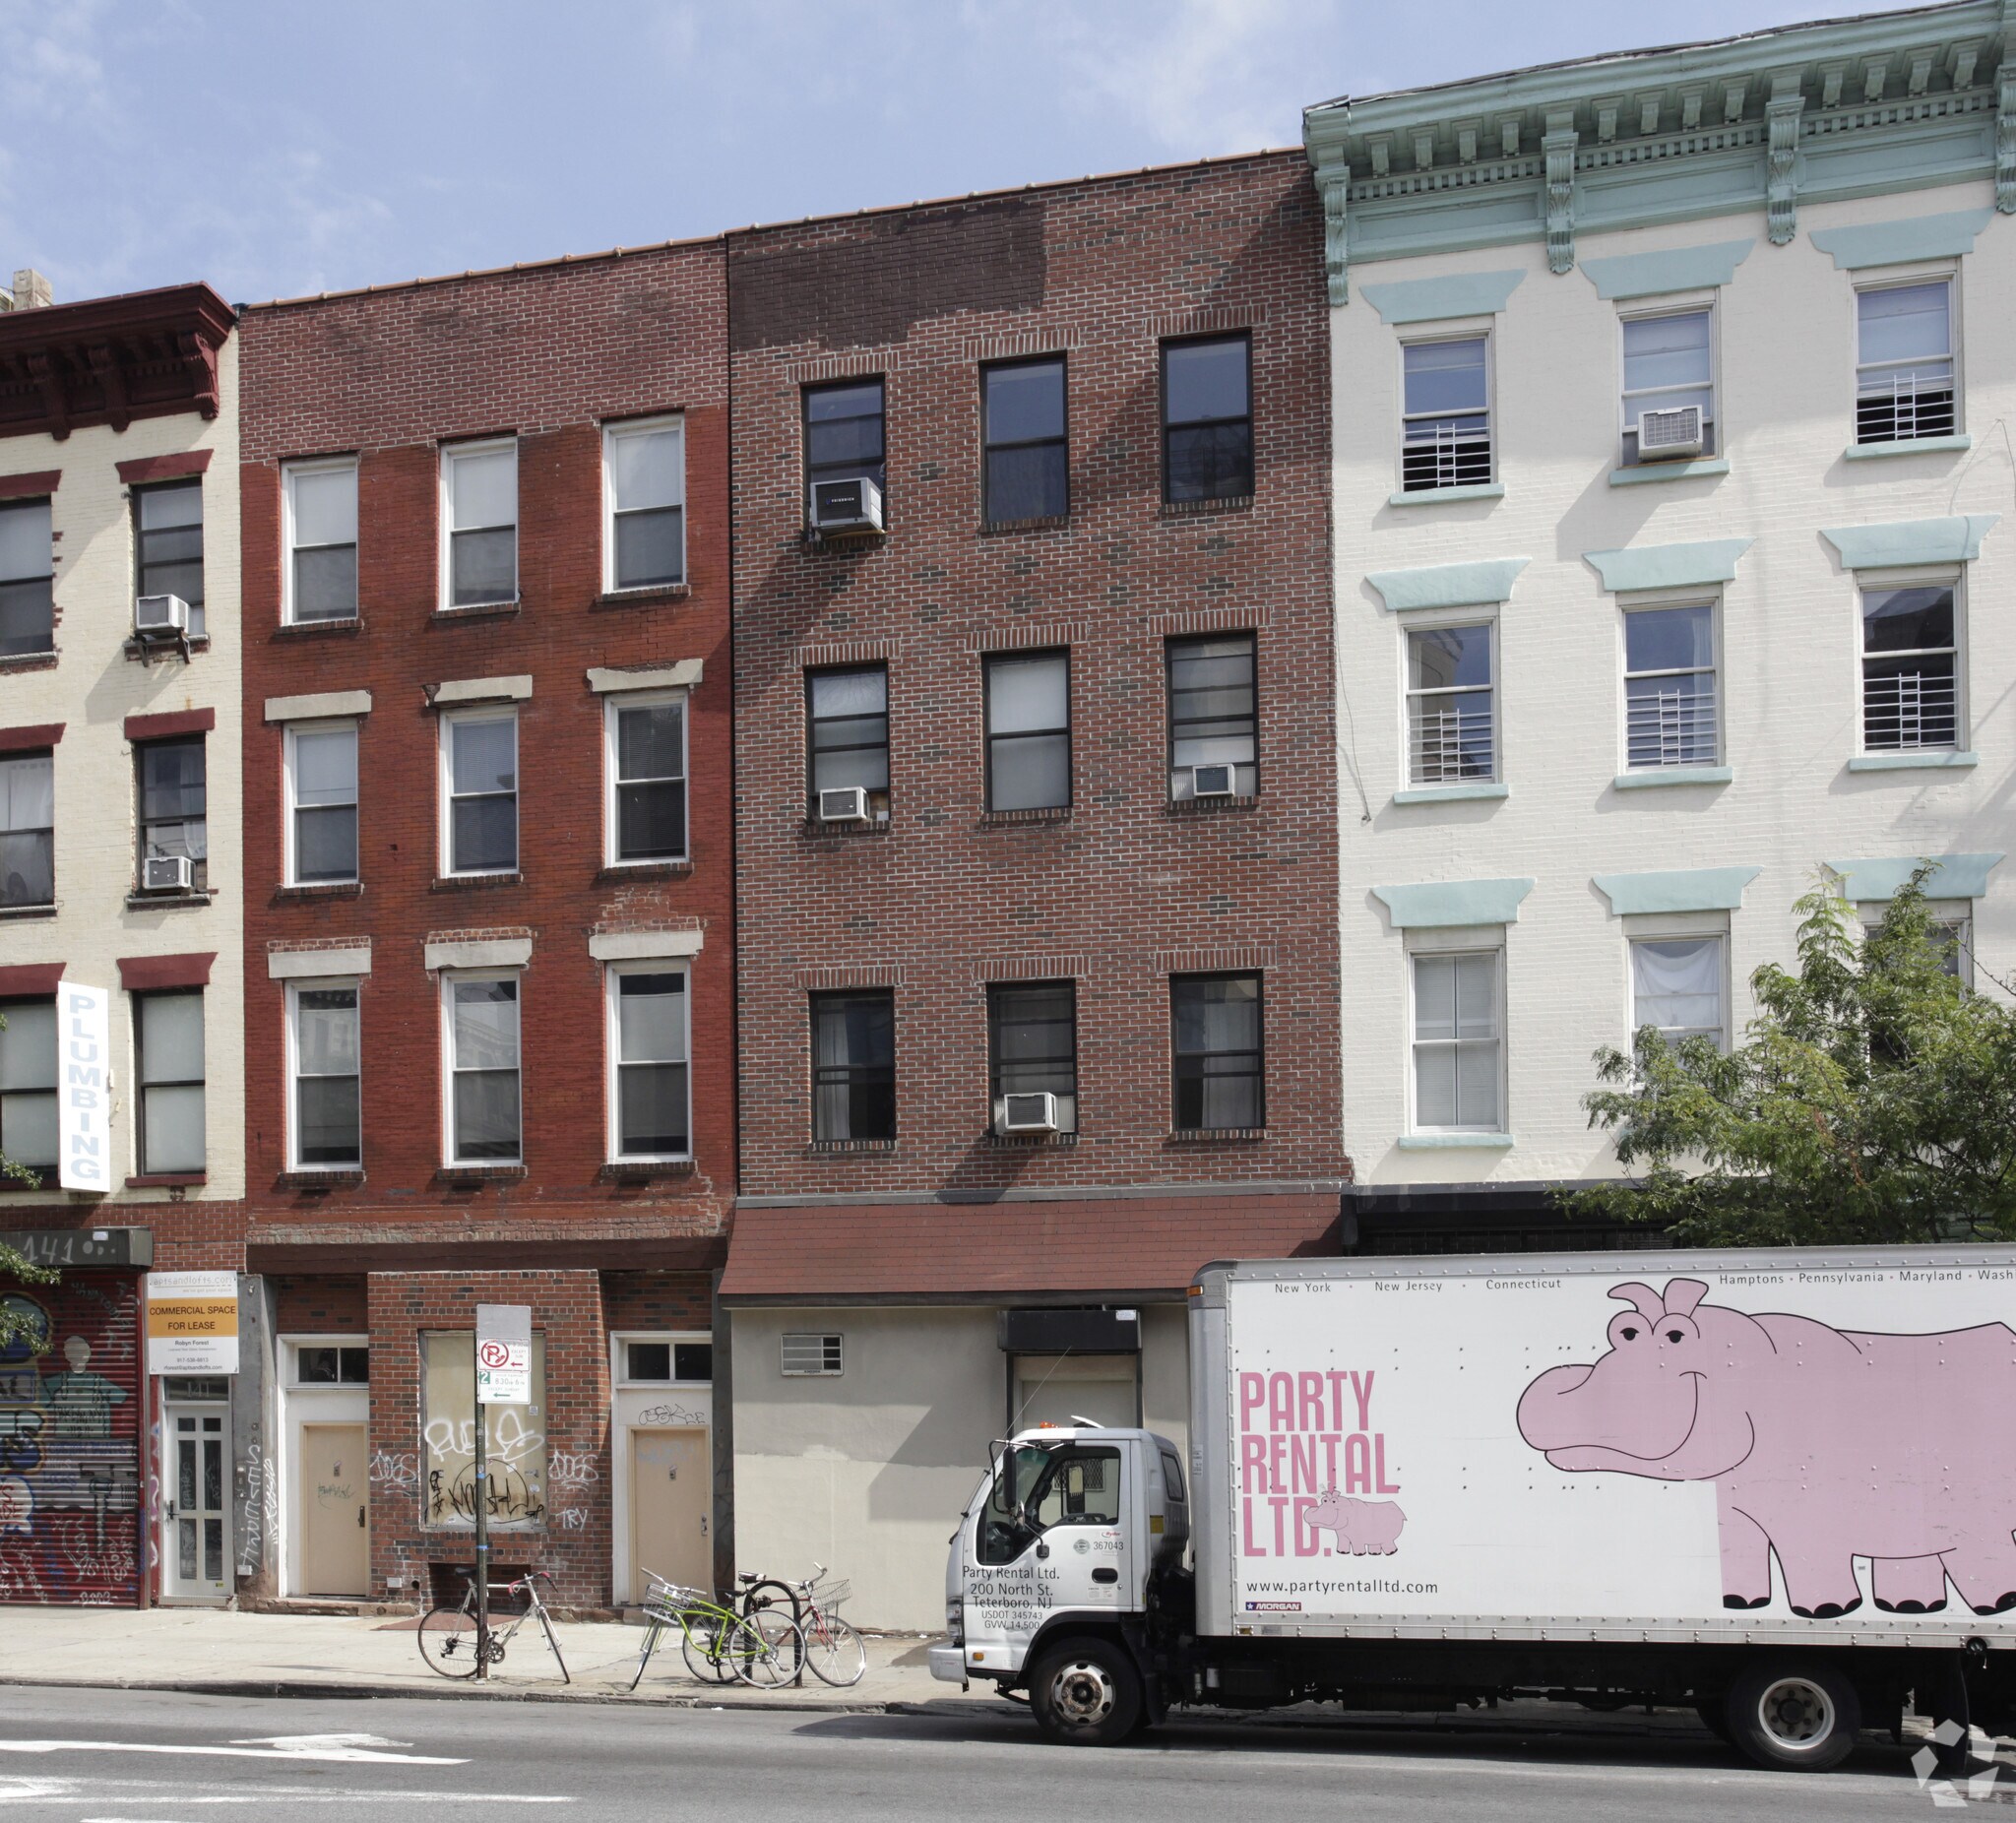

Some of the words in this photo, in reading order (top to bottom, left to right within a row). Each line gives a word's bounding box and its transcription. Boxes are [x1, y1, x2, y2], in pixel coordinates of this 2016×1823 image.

[69, 994, 100, 1179] PLUMBING
[24, 1235, 74, 1264] 141
[1275, 1283, 1299, 1293] New
[1304, 1283, 1331, 1292] York
[1374, 1281, 1400, 1291] New
[1406, 1281, 1443, 1292] Jersey
[1485, 1279, 1561, 1290] Connecticut
[1720, 1274, 1784, 1287] Hamptons
[1799, 1272, 1884, 1285] Pennsylvania
[1899, 1270, 1962, 1283] Maryland
[1978, 1269, 2016, 1280] Wash
[150, 1306, 206, 1316] COMMERCIAL
[207, 1305, 236, 1315] SPACE
[187, 1321, 216, 1330] LEASE
[480, 1371, 488, 1384] 2
[1239, 1370, 1375, 1432] PARTY
[1240, 1433, 1400, 1494] RENTAL
[1243, 1496, 1332, 1557] LTD.
[1093, 1540, 1124, 1550] 367043
[963, 1565, 992, 1581] Party
[996, 1567, 1034, 1579] Rental
[1038, 1567, 1060, 1580] Ltd.
[971, 1583, 994, 1595] 200
[998, 1583, 1033, 1595] North
[1037, 1583, 1053, 1596] St.
[1246, 1579, 1438, 1595] www.partyrentalltd.com
[973, 1596, 1033, 1609] Teterboro,
[1038, 1597, 1052, 1609] NJ
[981, 1610, 1009, 1619] USDOT
[1012, 1610, 1042, 1620] 345743
